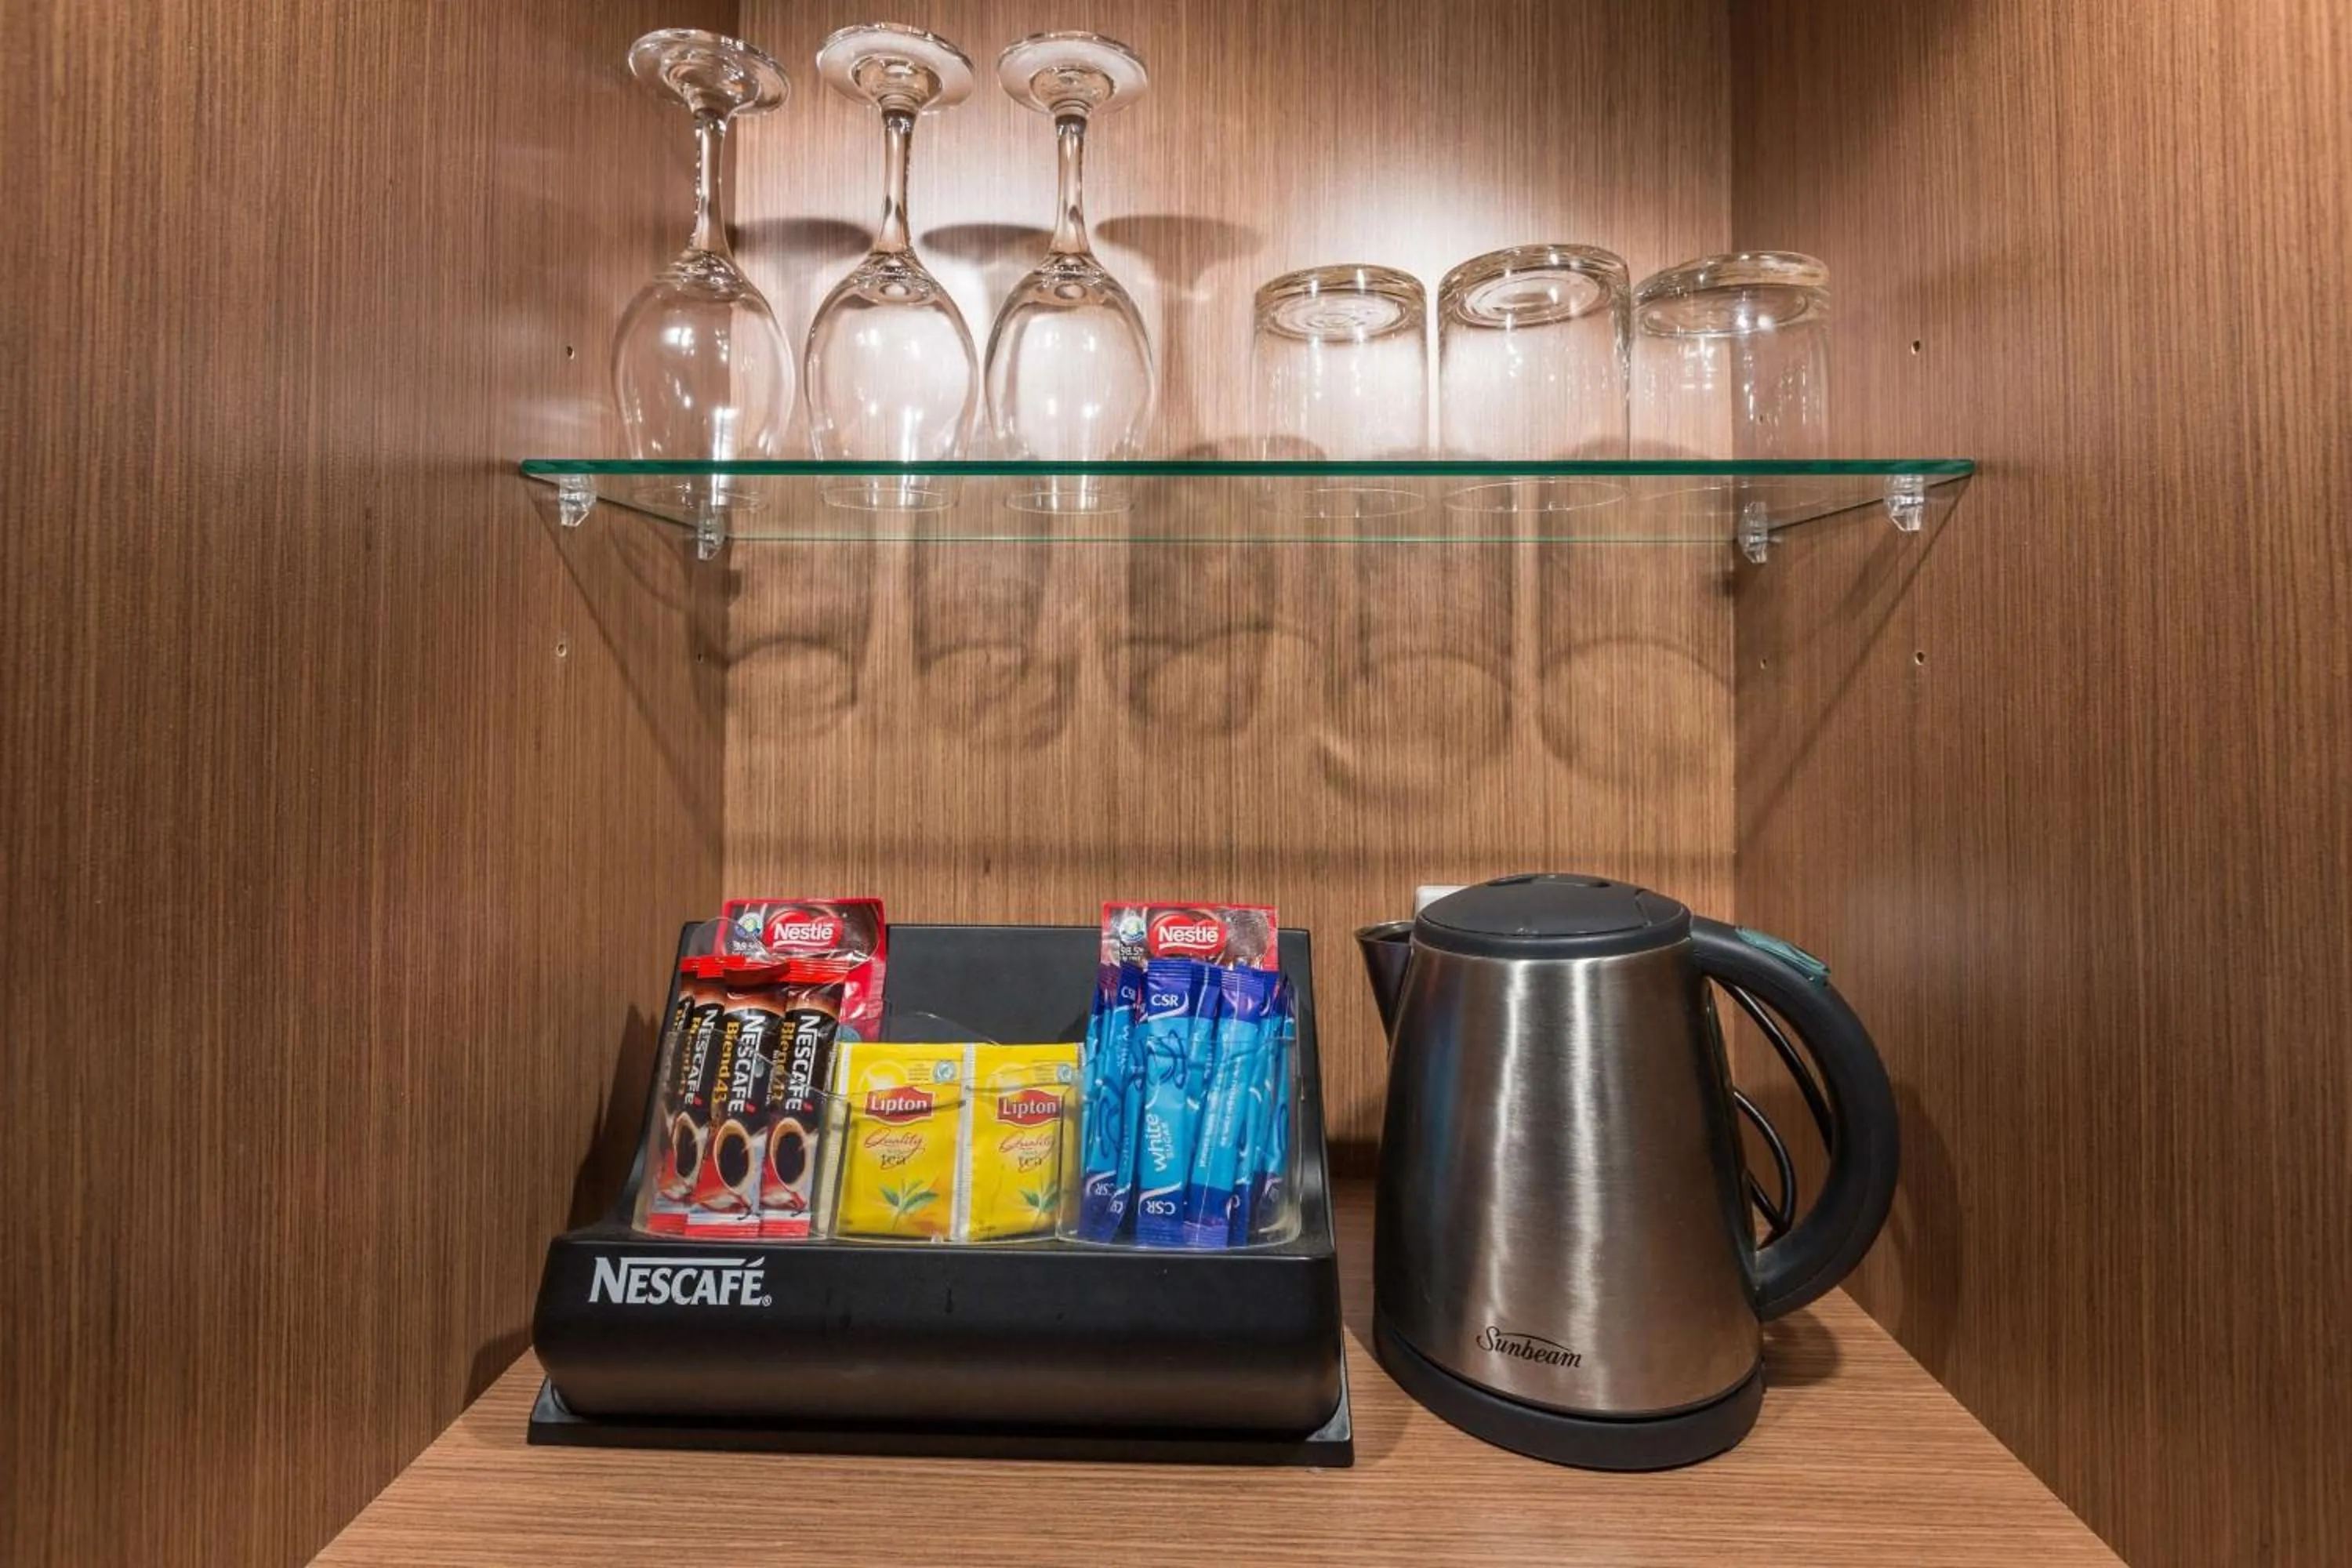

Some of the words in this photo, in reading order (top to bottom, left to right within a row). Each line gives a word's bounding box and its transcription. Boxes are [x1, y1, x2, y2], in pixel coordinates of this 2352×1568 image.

[1150, 993, 1179, 1007] CSR
[718, 1021, 741, 1079] Blend
[870, 1096, 928, 1116] Lipton
[1002, 1098, 1057, 1119] Lipton
[864, 1127, 926, 1160] Quality
[1144, 1112, 1168, 1173] white
[1146, 1200, 1176, 1214] CSR
[589, 1256, 766, 1306] NESCAFÉ
[1475, 1326, 1581, 1368] Sunbeam
